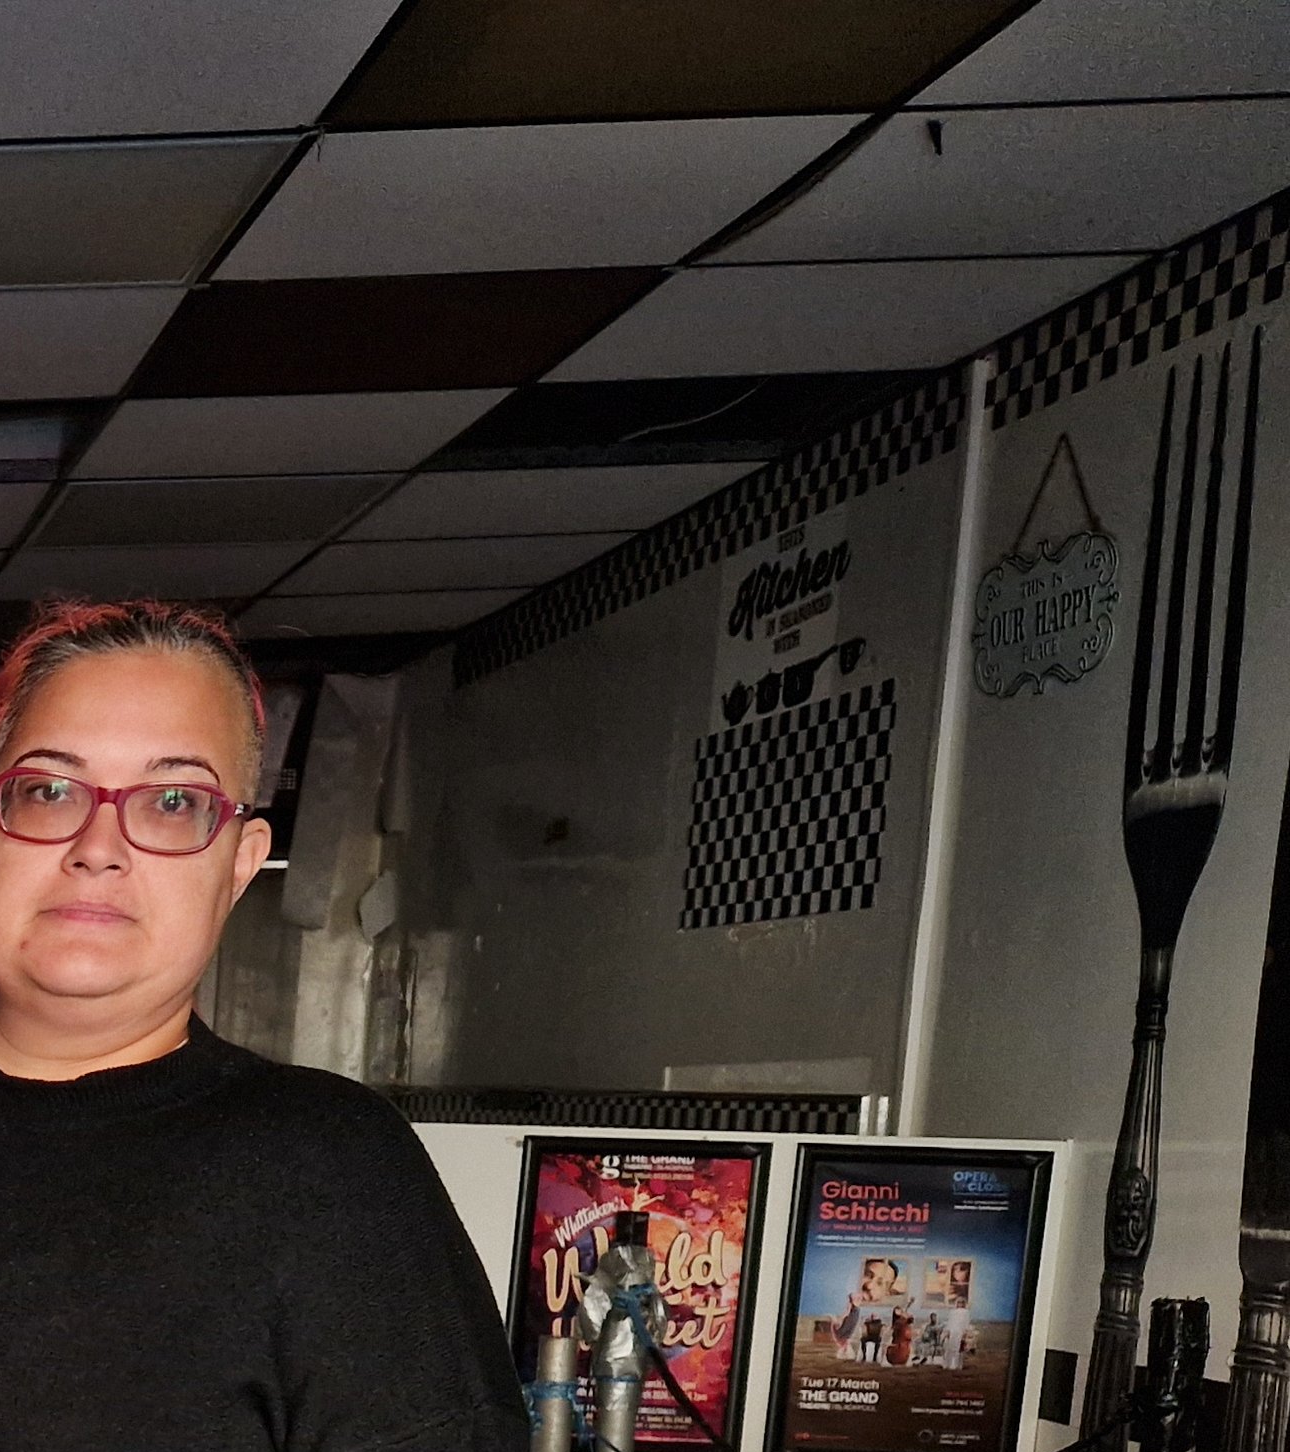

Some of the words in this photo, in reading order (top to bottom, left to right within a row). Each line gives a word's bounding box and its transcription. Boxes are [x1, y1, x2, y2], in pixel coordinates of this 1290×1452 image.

[728, 540, 851, 640] Kitchen
[990, 606, 1025, 648] OUR
[1035, 584, 1096, 637] HAPPY
[1021, 637, 1057, 664] PLACE
[821, 1180, 900, 1200] Gianni
[554, 1196, 628, 1248] Whittaker's
[820, 1201, 931, 1223] Schicchi
[801, 1376, 823, 1388] Tue
[826, 1377, 837, 1388] 17
[840, 1378, 880, 1390] March
[799, 1389, 828, 1402] THE
[828, 1391, 879, 1404] GRAND
